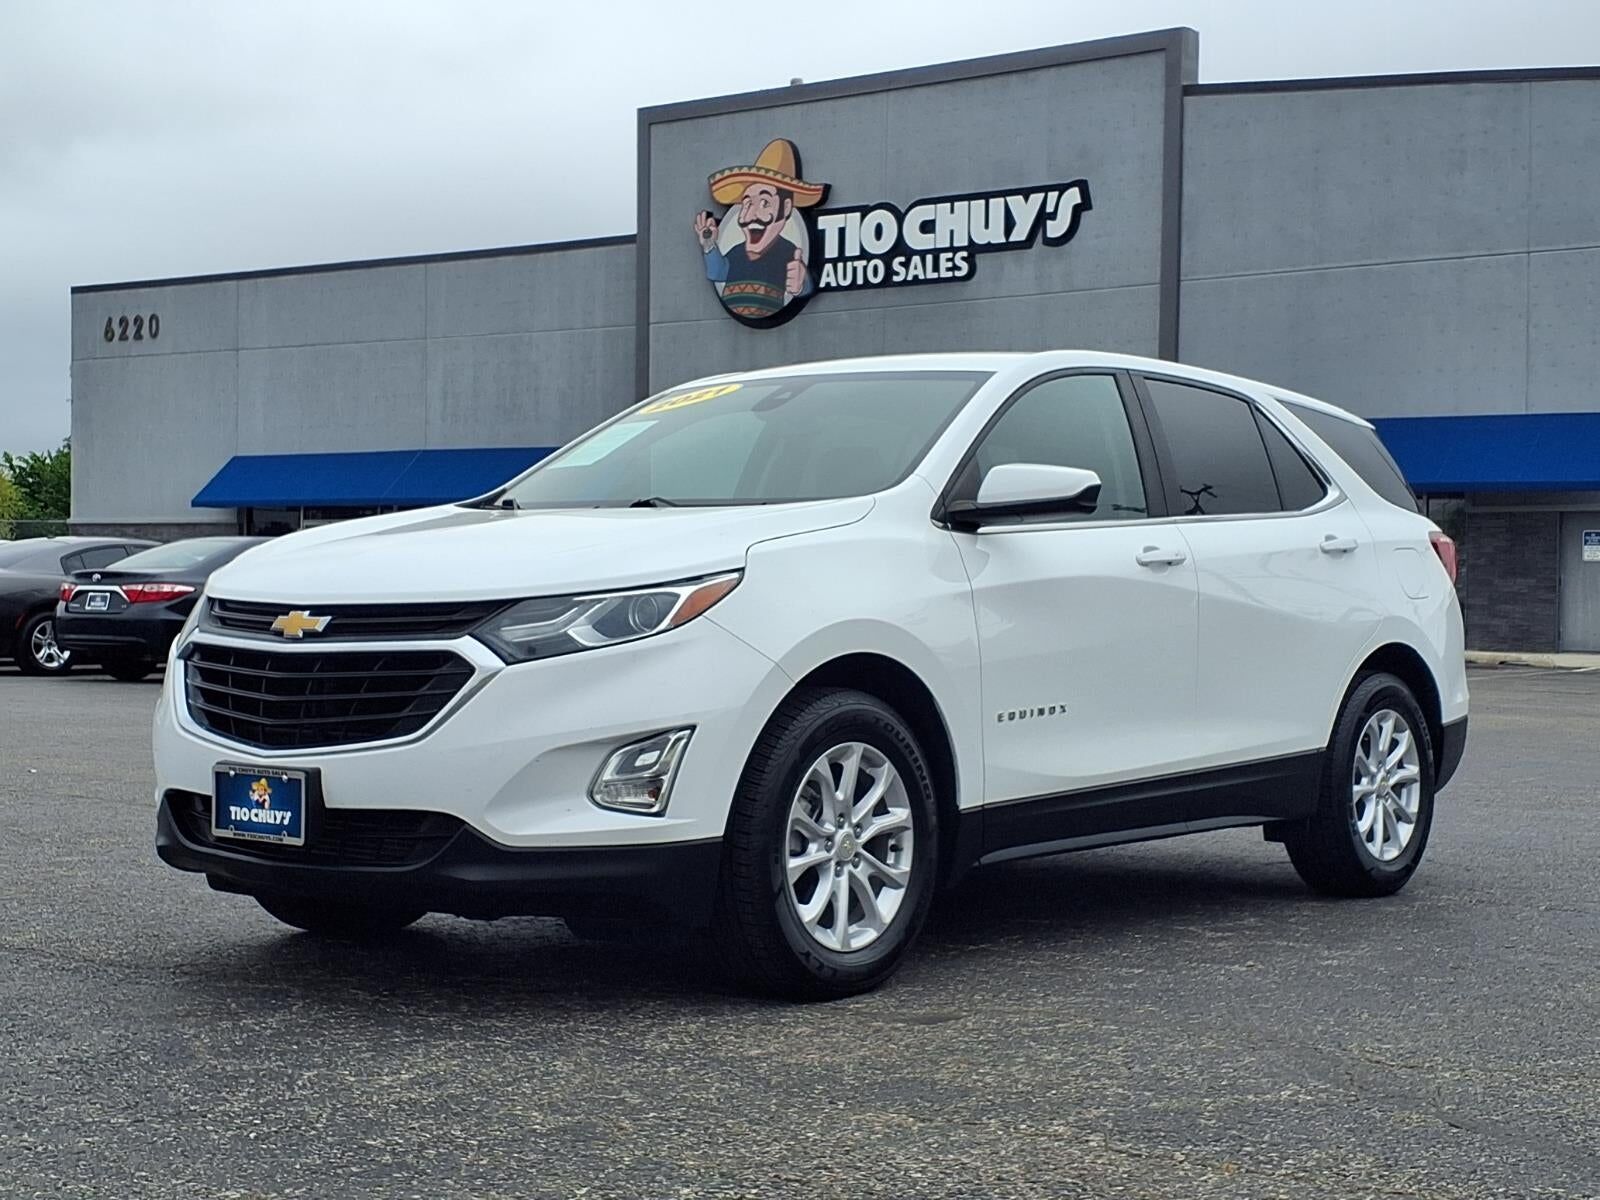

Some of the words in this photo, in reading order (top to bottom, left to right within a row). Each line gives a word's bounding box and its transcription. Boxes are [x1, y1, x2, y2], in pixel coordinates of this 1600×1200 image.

[817, 208, 898, 259] TIO
[902, 185, 1082, 251] CHUY'S
[819, 258, 886, 289] AUTO
[892, 251, 970, 283] SALES
[103, 313, 160, 342] 6220
[997, 704, 1067, 723] EQUINOX
[872, 714, 935, 802] TOURING
[229, 805, 250, 821] TIO
[250, 808, 292, 826] CHUY'S
